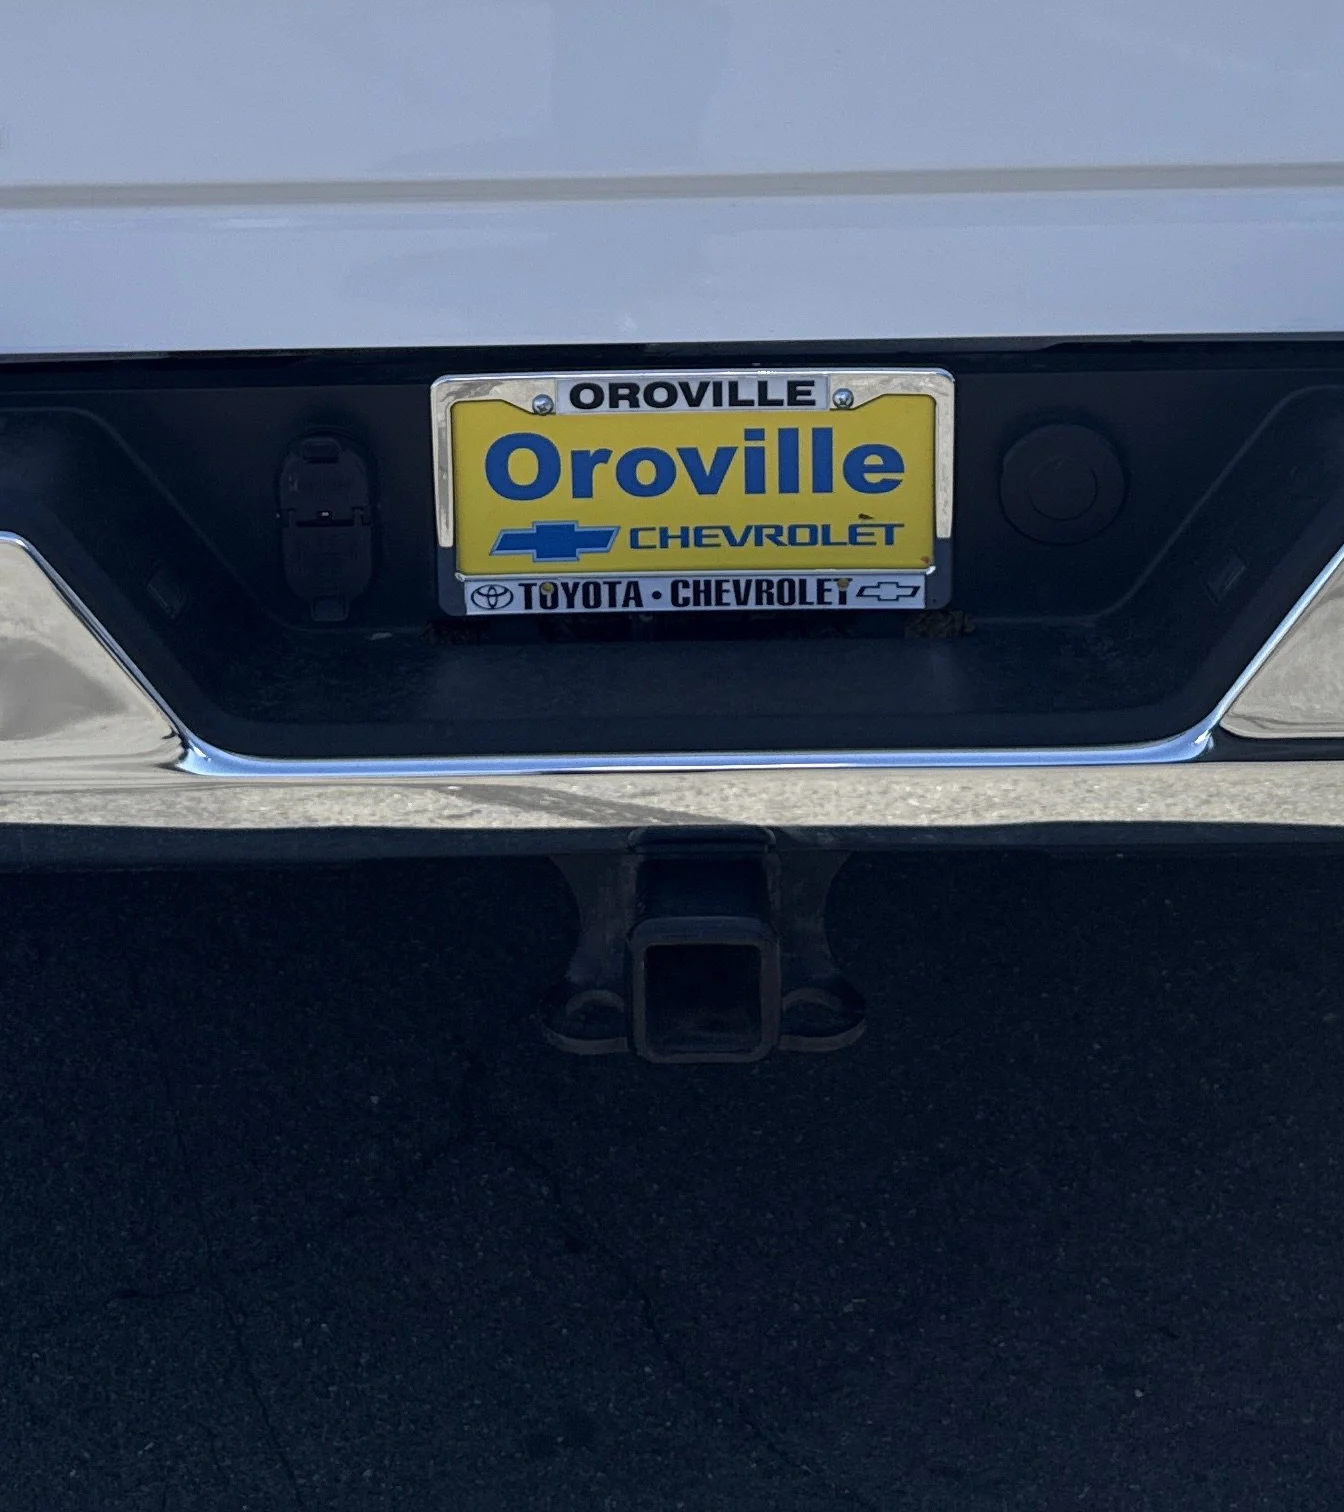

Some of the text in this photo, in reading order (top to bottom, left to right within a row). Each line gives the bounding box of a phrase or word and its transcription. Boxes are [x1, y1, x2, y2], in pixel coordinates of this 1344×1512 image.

[568, 379, 816, 410] OROVILLE
[484, 426, 906, 502] Oroville
[629, 522, 905, 550] CHEVROLET
[518, 576, 854, 611] TOYOTA CHEVROLET
